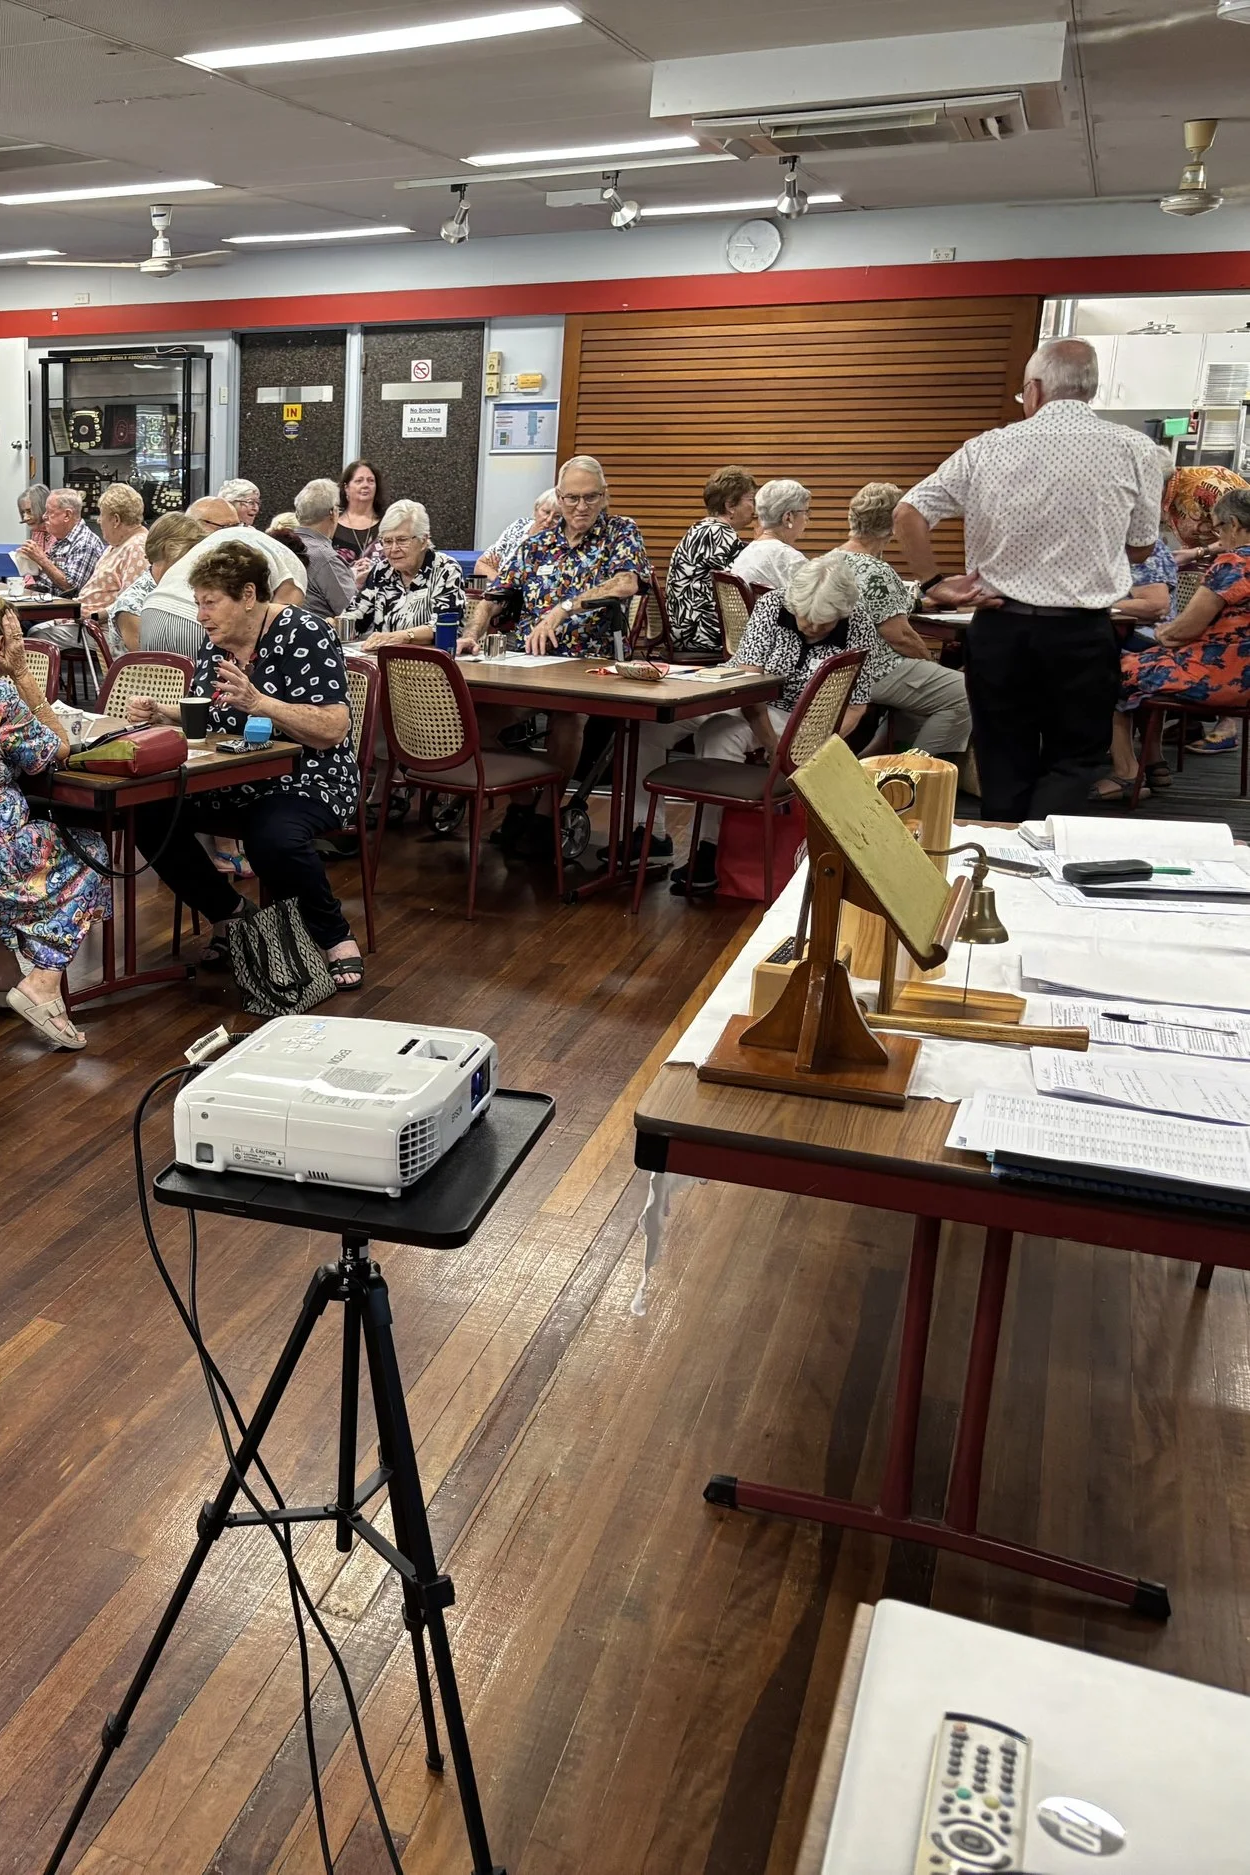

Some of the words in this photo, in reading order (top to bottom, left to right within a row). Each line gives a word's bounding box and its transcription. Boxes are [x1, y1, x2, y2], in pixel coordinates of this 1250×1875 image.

[287, 408, 298, 417] IN
[328, 1049, 352, 1065] EPSON
[256, 1148, 277, 1156] CAUTION
